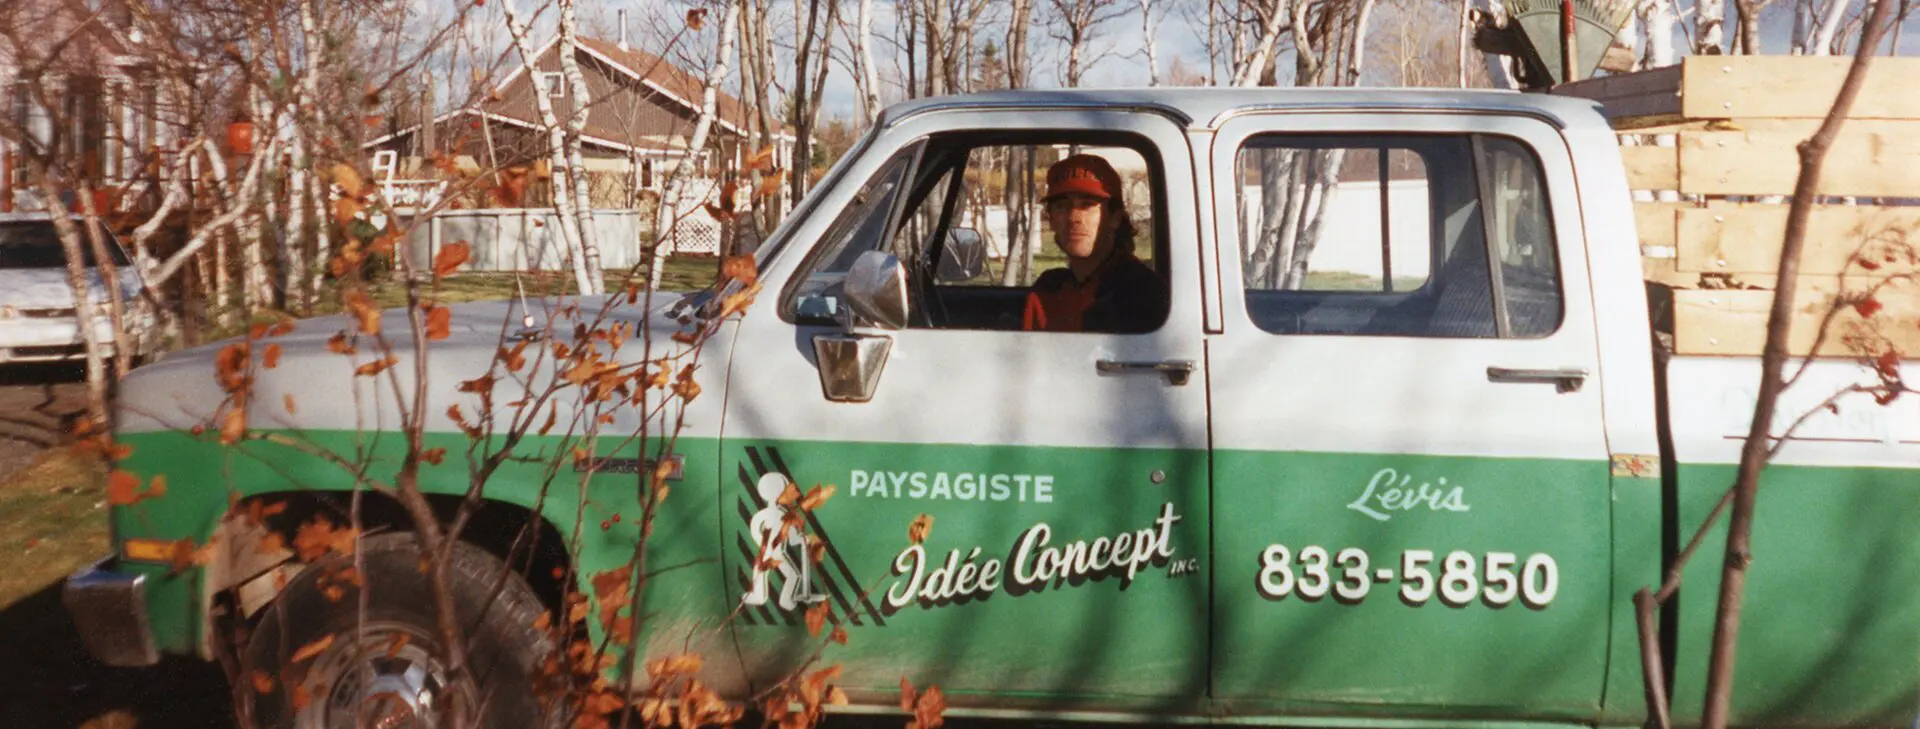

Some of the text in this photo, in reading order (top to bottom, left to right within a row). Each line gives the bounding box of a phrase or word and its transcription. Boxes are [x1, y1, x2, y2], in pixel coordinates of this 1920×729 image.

[850, 469, 1054, 503] PAYSAGISTE
[1347, 467, 1471, 521] Lévis
[1011, 502, 1182, 582] Concept
[1170, 558, 1200, 575] INC.
[1258, 544, 1559, 607] 833-5850
